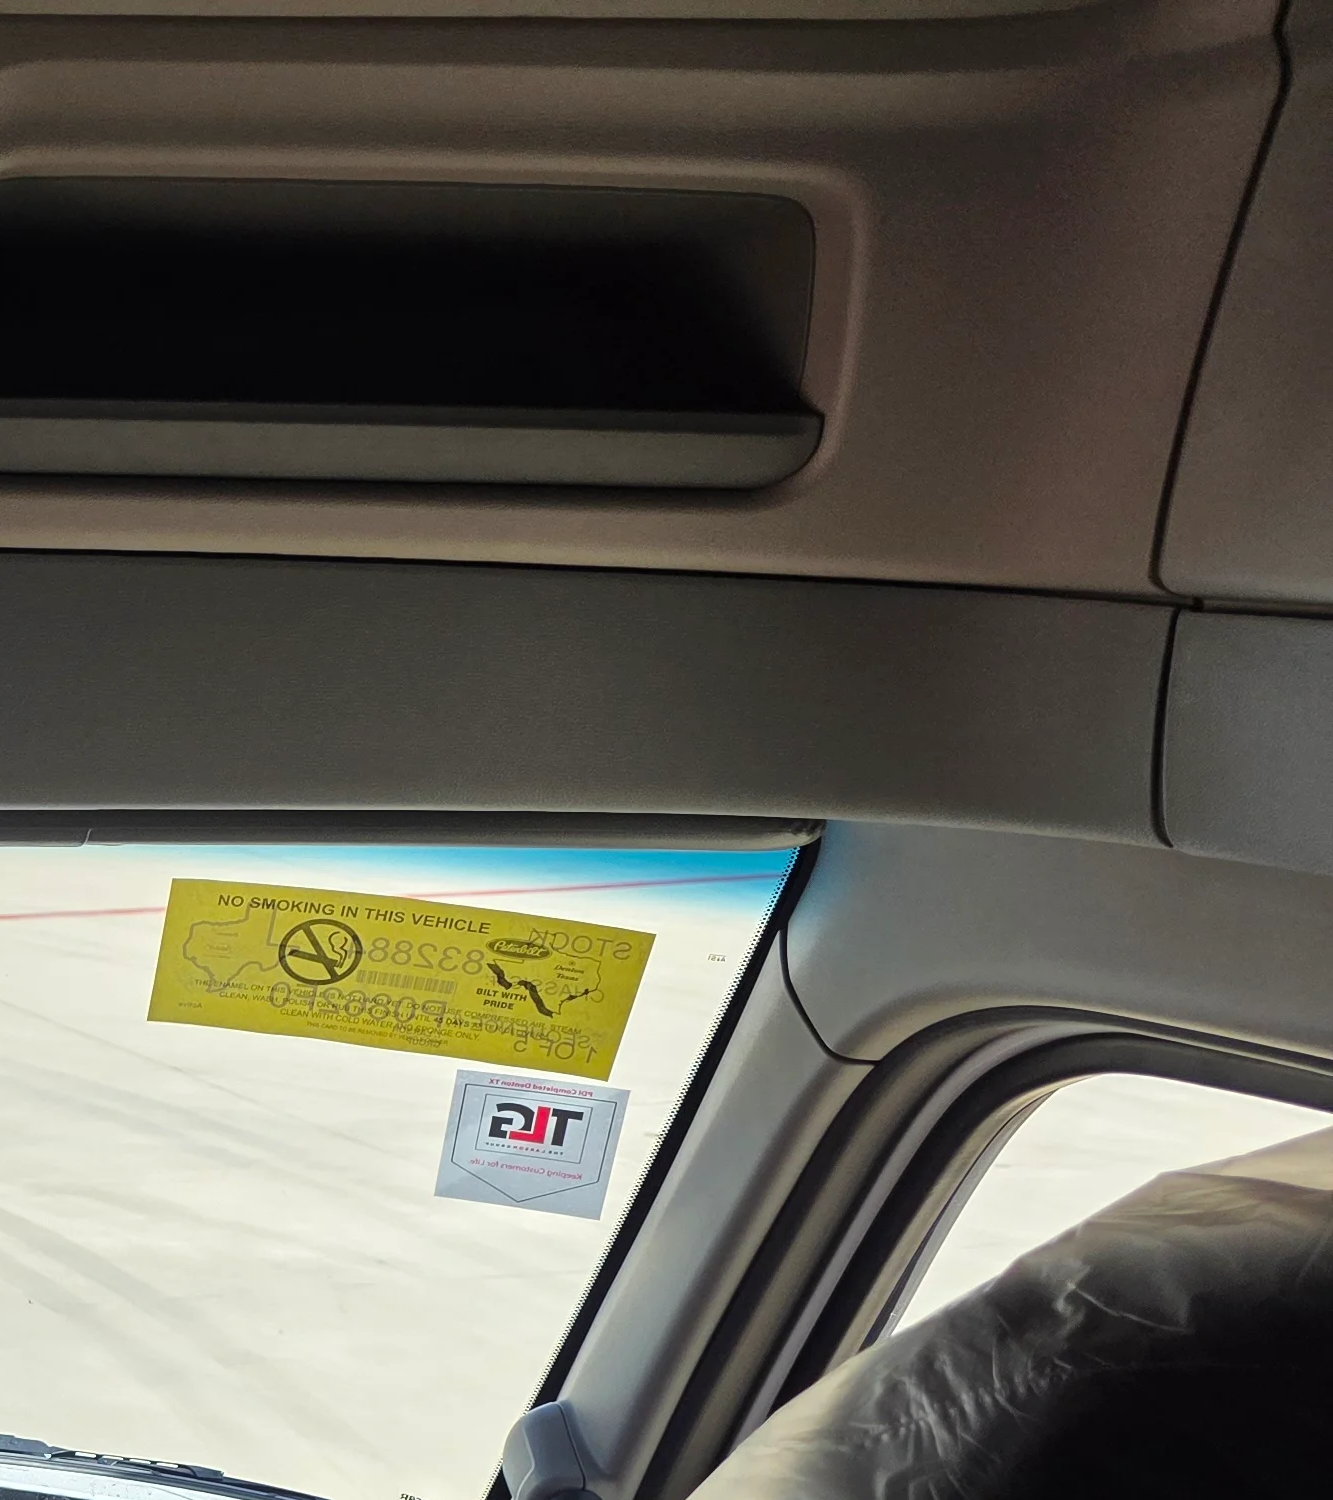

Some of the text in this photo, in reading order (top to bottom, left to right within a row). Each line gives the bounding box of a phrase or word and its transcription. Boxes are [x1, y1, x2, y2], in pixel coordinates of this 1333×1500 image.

[218, 894, 491, 934] NO SMOKING IN THIS VEHICLE
[493, 941, 547, 957] Peterbilt
[554, 965, 584, 974] Denton
[556, 973, 579, 981] Texas
[476, 988, 528, 1002] BILT WITH
[219, 992, 249, 1001] CLEAN,
[446, 1018, 469, 1028] DAYS
[251, 983, 264, 991] ON
[406, 1002, 420, 1010] DO
[421, 1003, 441, 1012] NOT
[444, 1007, 462, 1016] USE
[464, 1010, 528, 1027] COMPRESSED
[549, 1023, 581, 1035] STEAM
[483, 999, 515, 1010] PRIDE
[280, 1008, 309, 1018] CLEAN
[311, 1011, 333, 1020] WITH
[335, 1015, 360, 1024] COLD
[362, 1019, 393, 1029] WATER
[455, 1031, 480, 1041] ONLY.
